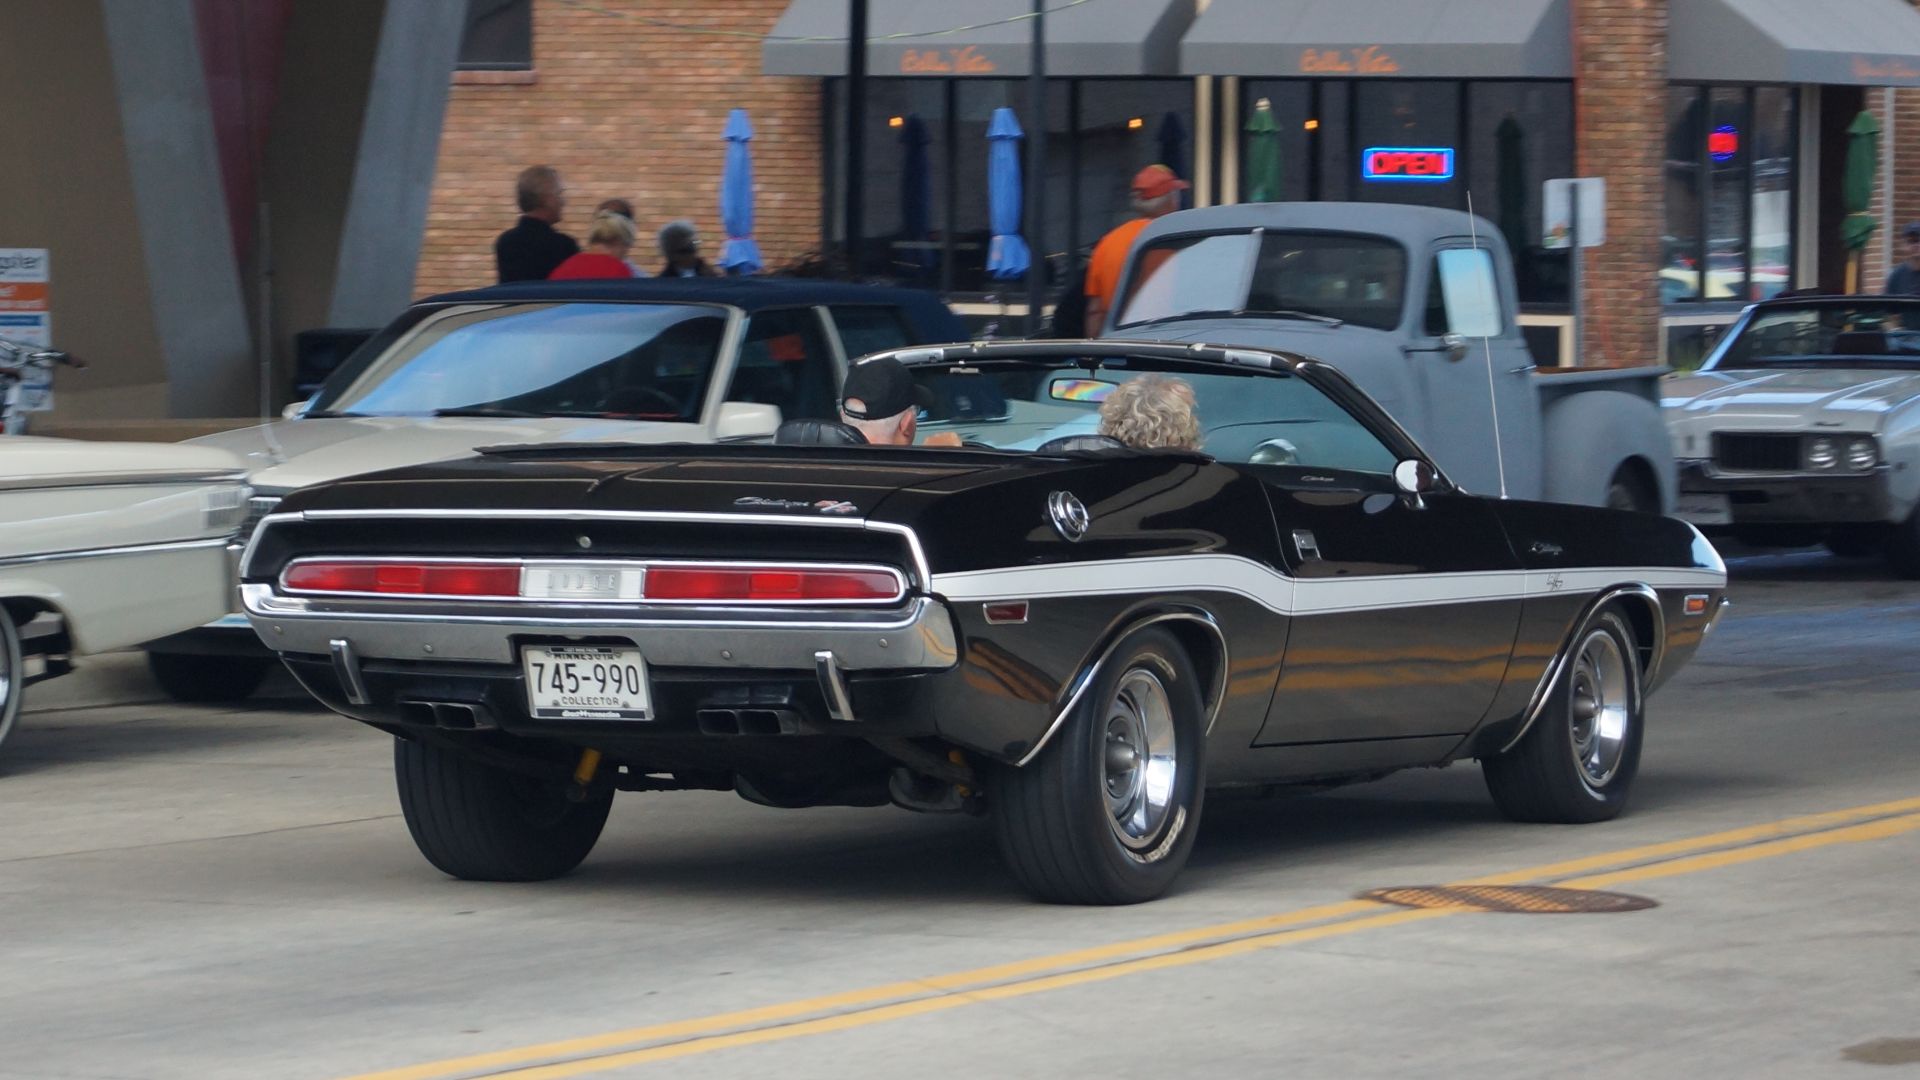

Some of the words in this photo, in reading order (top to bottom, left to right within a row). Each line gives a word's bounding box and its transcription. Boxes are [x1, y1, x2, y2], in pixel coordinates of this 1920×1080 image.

[1367, 152, 1448, 174] OPEN
[531, 662, 639, 695] 745-990
[561, 696, 619, 706] COLLECTOR
